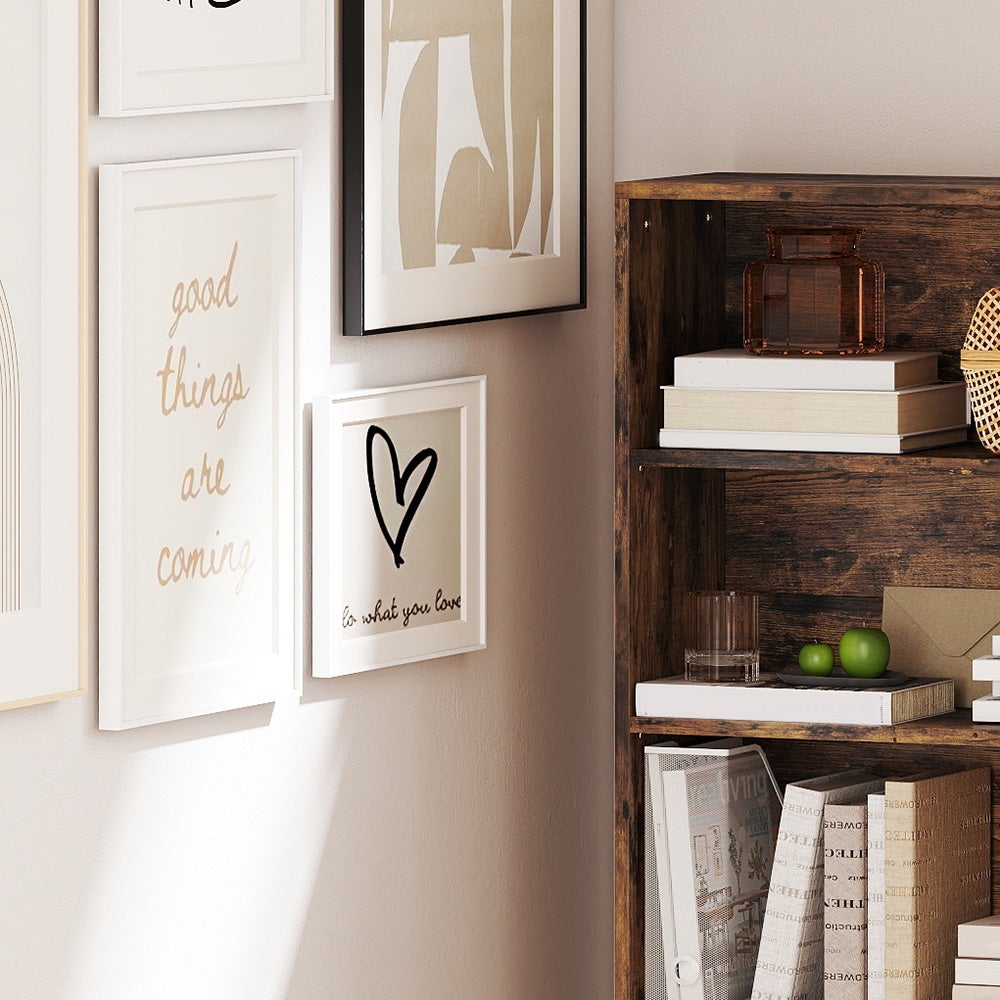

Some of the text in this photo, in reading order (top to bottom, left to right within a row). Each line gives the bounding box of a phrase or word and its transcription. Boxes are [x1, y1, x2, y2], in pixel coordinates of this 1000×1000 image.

[168, 241, 239, 339] good
[156, 345, 251, 430] things
[181, 452, 231, 501] are
[158, 530, 254, 594] coming
[362, 599, 399, 624] what
[403, 603, 431, 627] you
[435, 588, 462, 611] love
